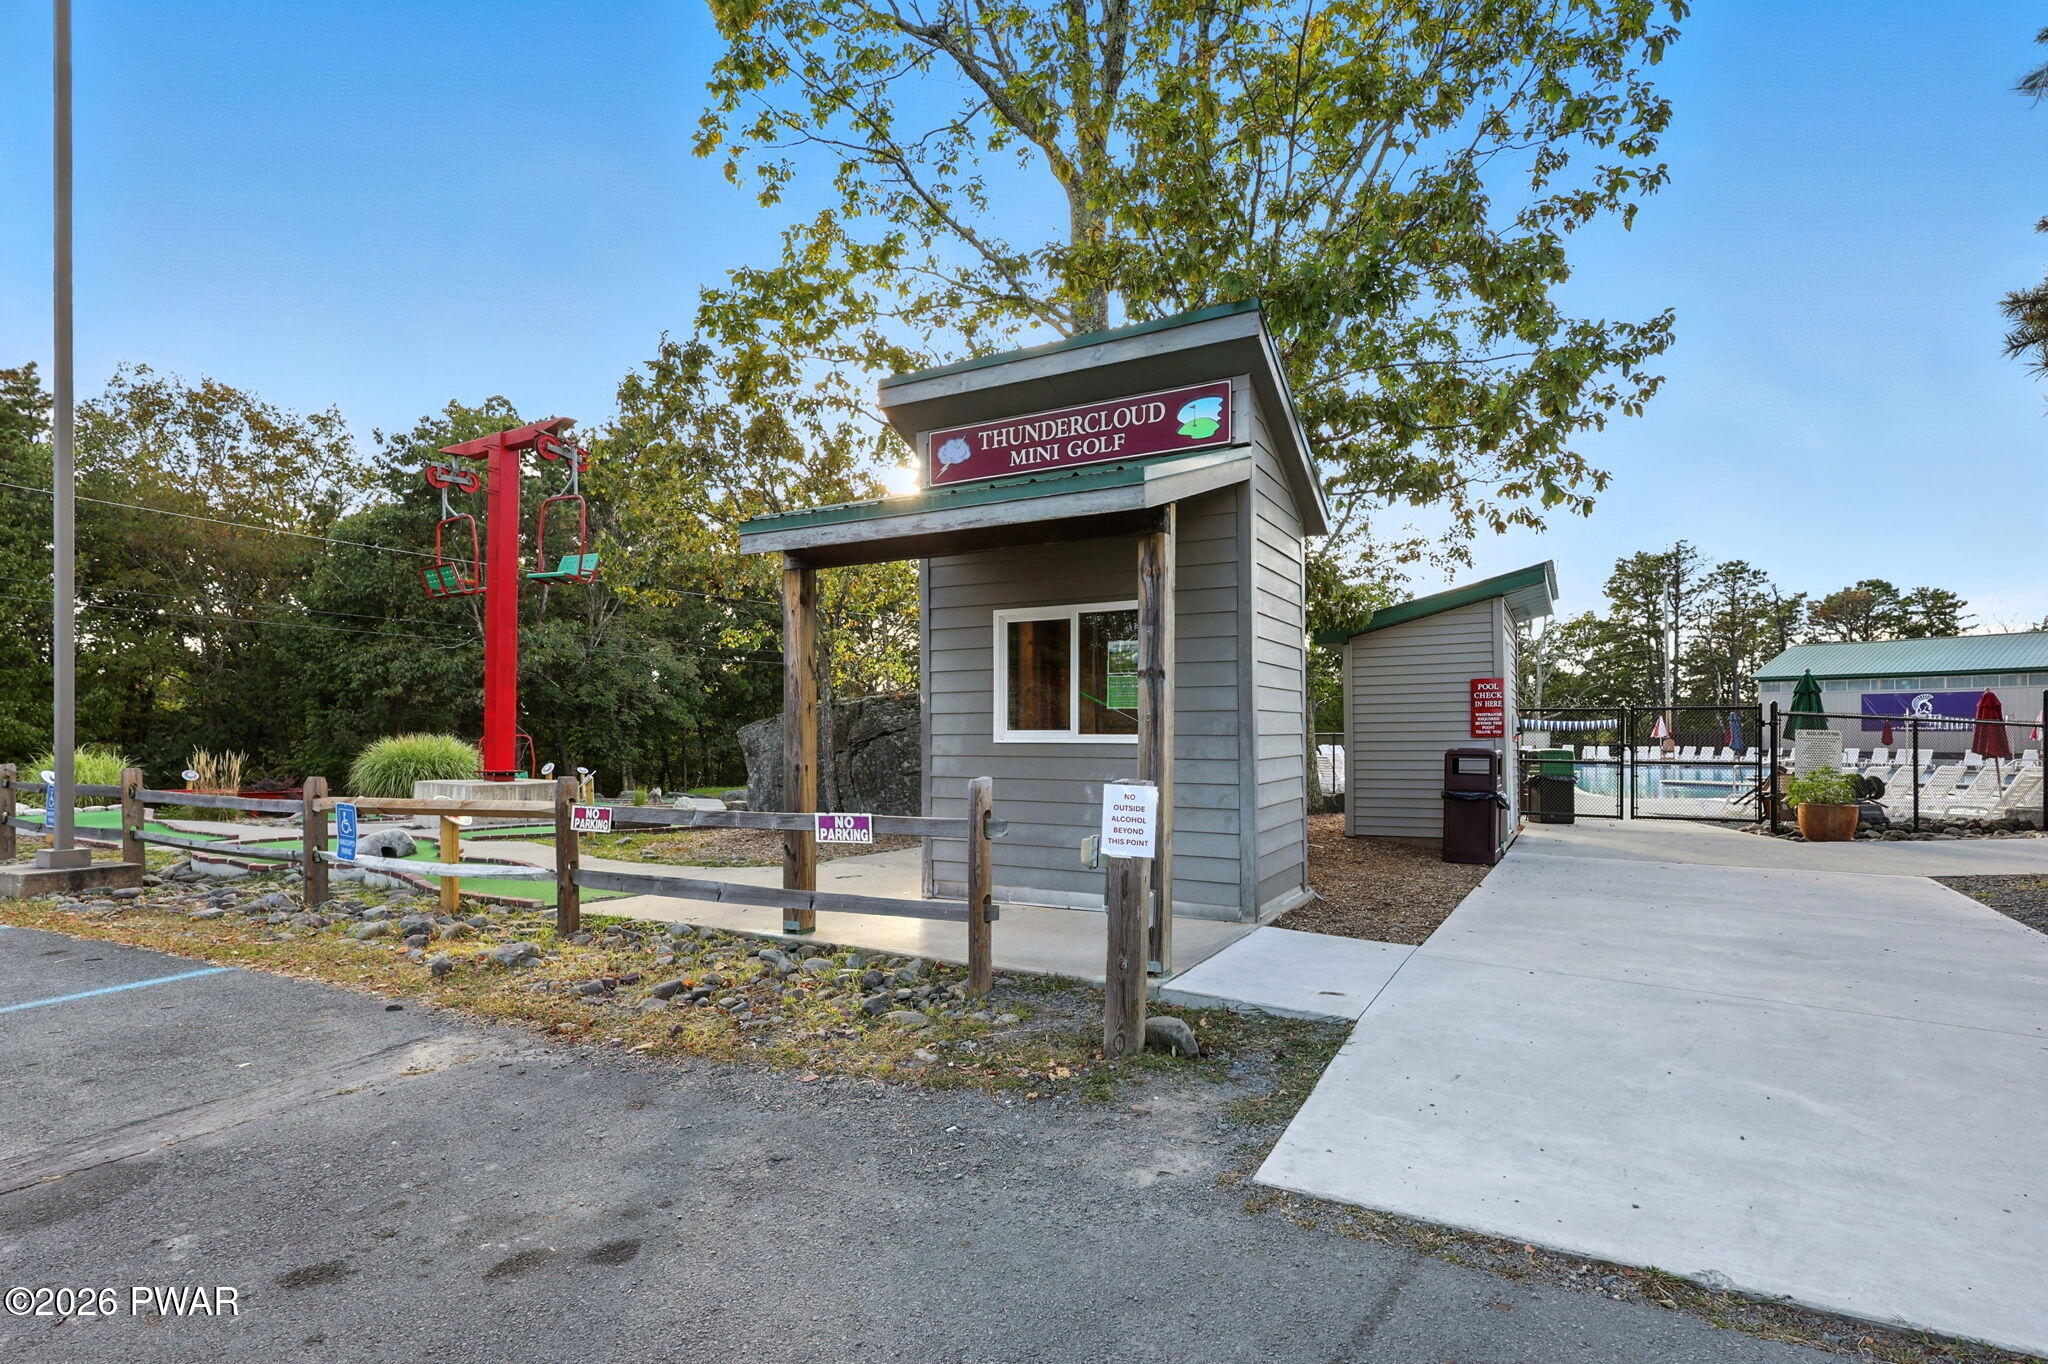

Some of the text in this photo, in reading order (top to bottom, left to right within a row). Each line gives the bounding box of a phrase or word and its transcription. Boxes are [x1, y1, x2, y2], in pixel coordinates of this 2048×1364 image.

[978, 402, 1166, 451] THUNDERCLOUD
[1009, 433, 1126, 467] MINI GOLF
[1473, 691, 1503, 699] CHECK
[585, 808, 600, 819] NO
[1113, 804, 1146, 812] OUTSIDE
[574, 817, 608, 830] PARKING
[834, 816, 854, 828] NO
[1111, 815, 1147, 824] ALCOHOL
[820, 827, 868, 842] PARKING
[1113, 826, 1144, 835] BEYOND
[1108, 837, 1149, 847] THIS POINT
